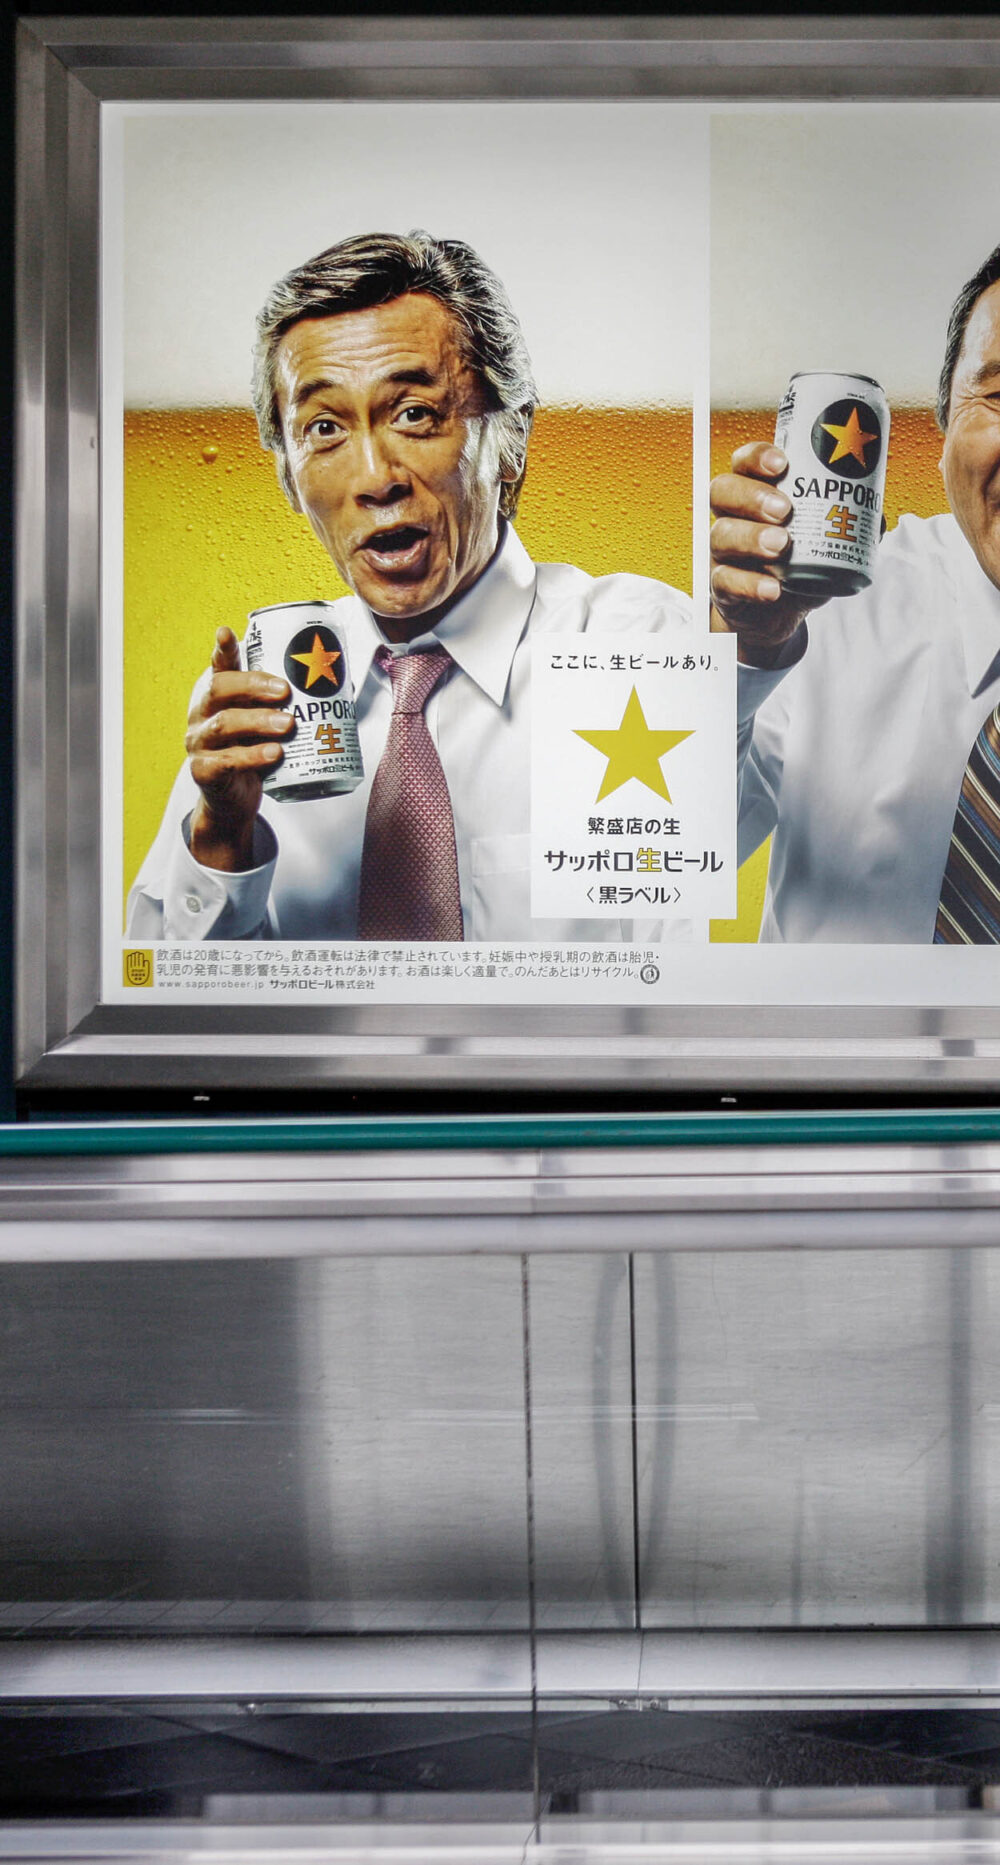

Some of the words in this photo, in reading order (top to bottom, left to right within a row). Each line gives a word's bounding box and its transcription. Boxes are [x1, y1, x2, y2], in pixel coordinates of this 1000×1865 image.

[824, 504, 858, 544] 生
[550, 653, 720, 672] ここに、生ビールあり。
[315, 723, 345, 755] 生
[587, 817, 681, 835] 繁盛店の生
[544, 847, 724, 873] サッポロ生ビール
[158, 980, 264, 989] www.sapporobeer.jp
[269, 979, 376, 990] サッポロビール株式会社
